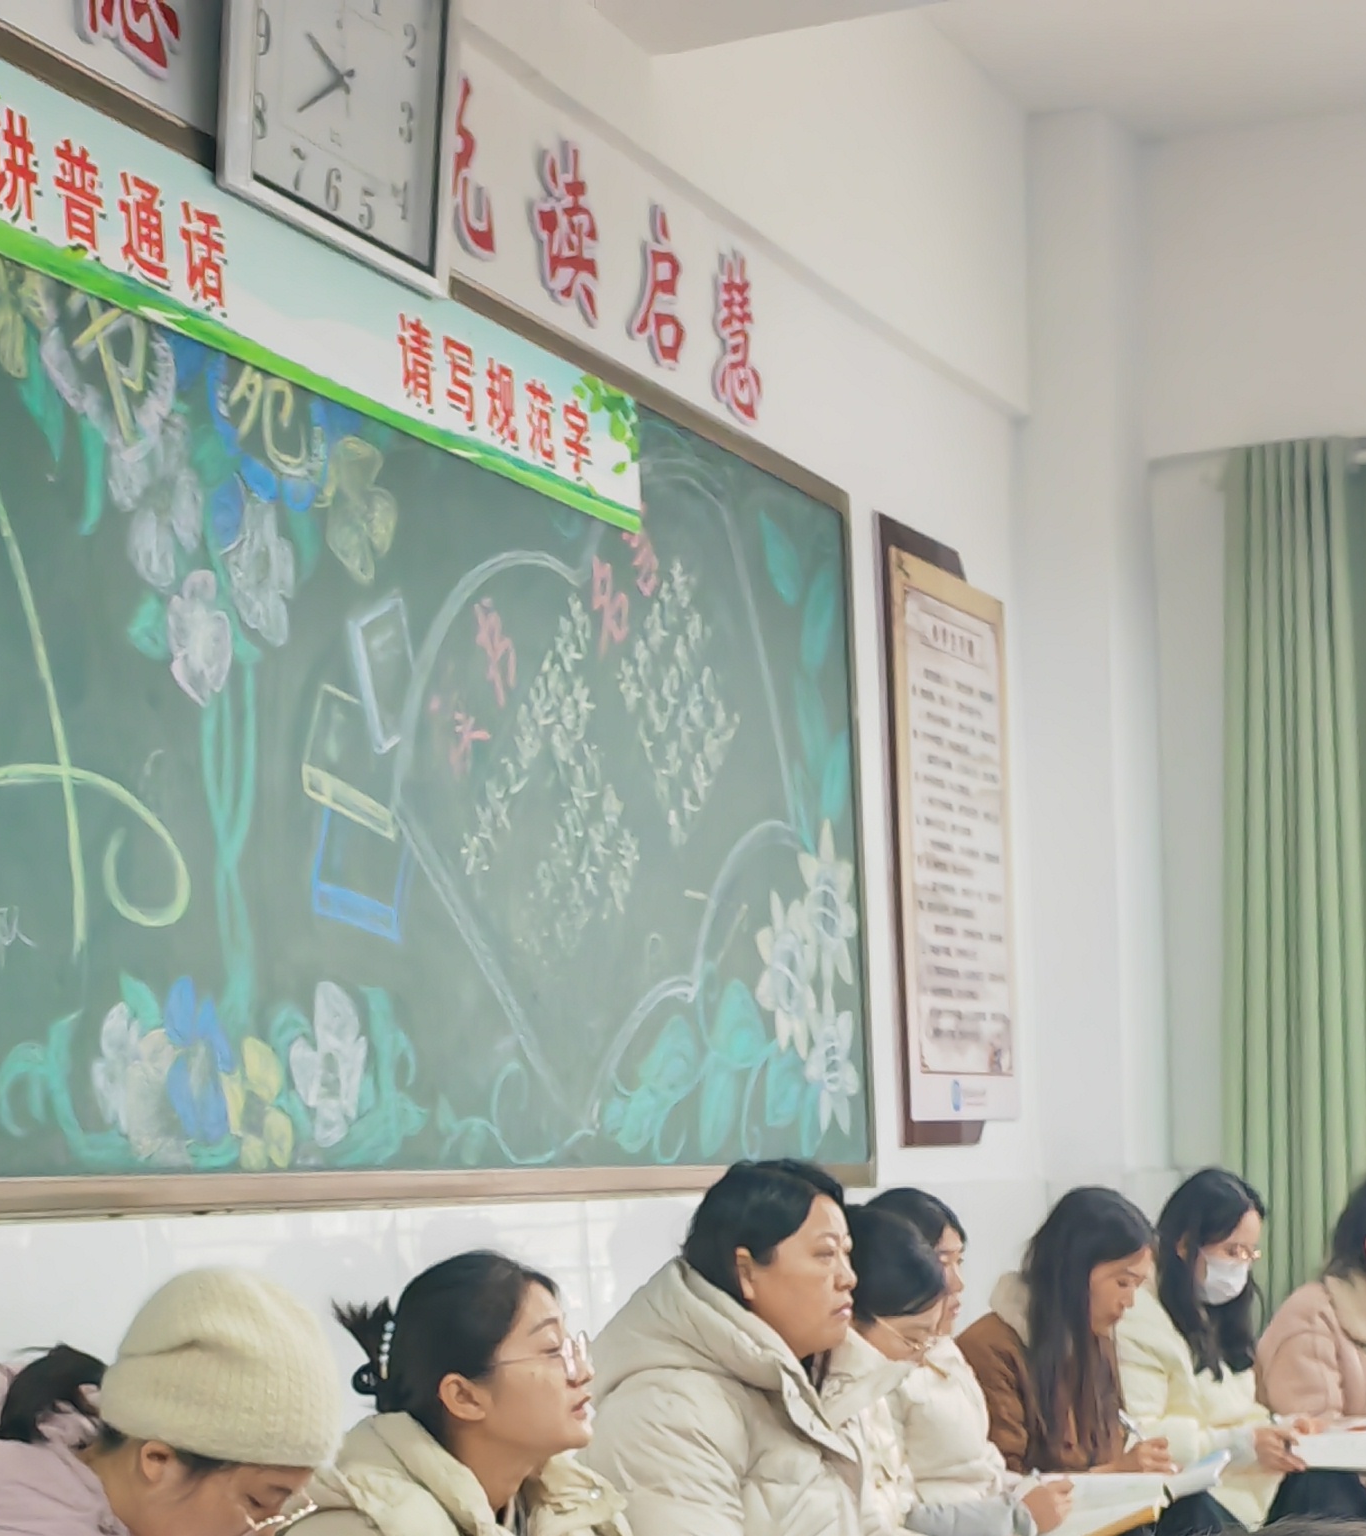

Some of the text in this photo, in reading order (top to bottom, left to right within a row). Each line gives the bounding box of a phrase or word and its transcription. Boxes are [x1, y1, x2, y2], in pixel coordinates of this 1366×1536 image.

[399, 101, 414, 144] 3
[326, 168, 342, 211] 6
[358, 187, 374, 230] 5
[396, 313, 593, 477] 请写规范字
